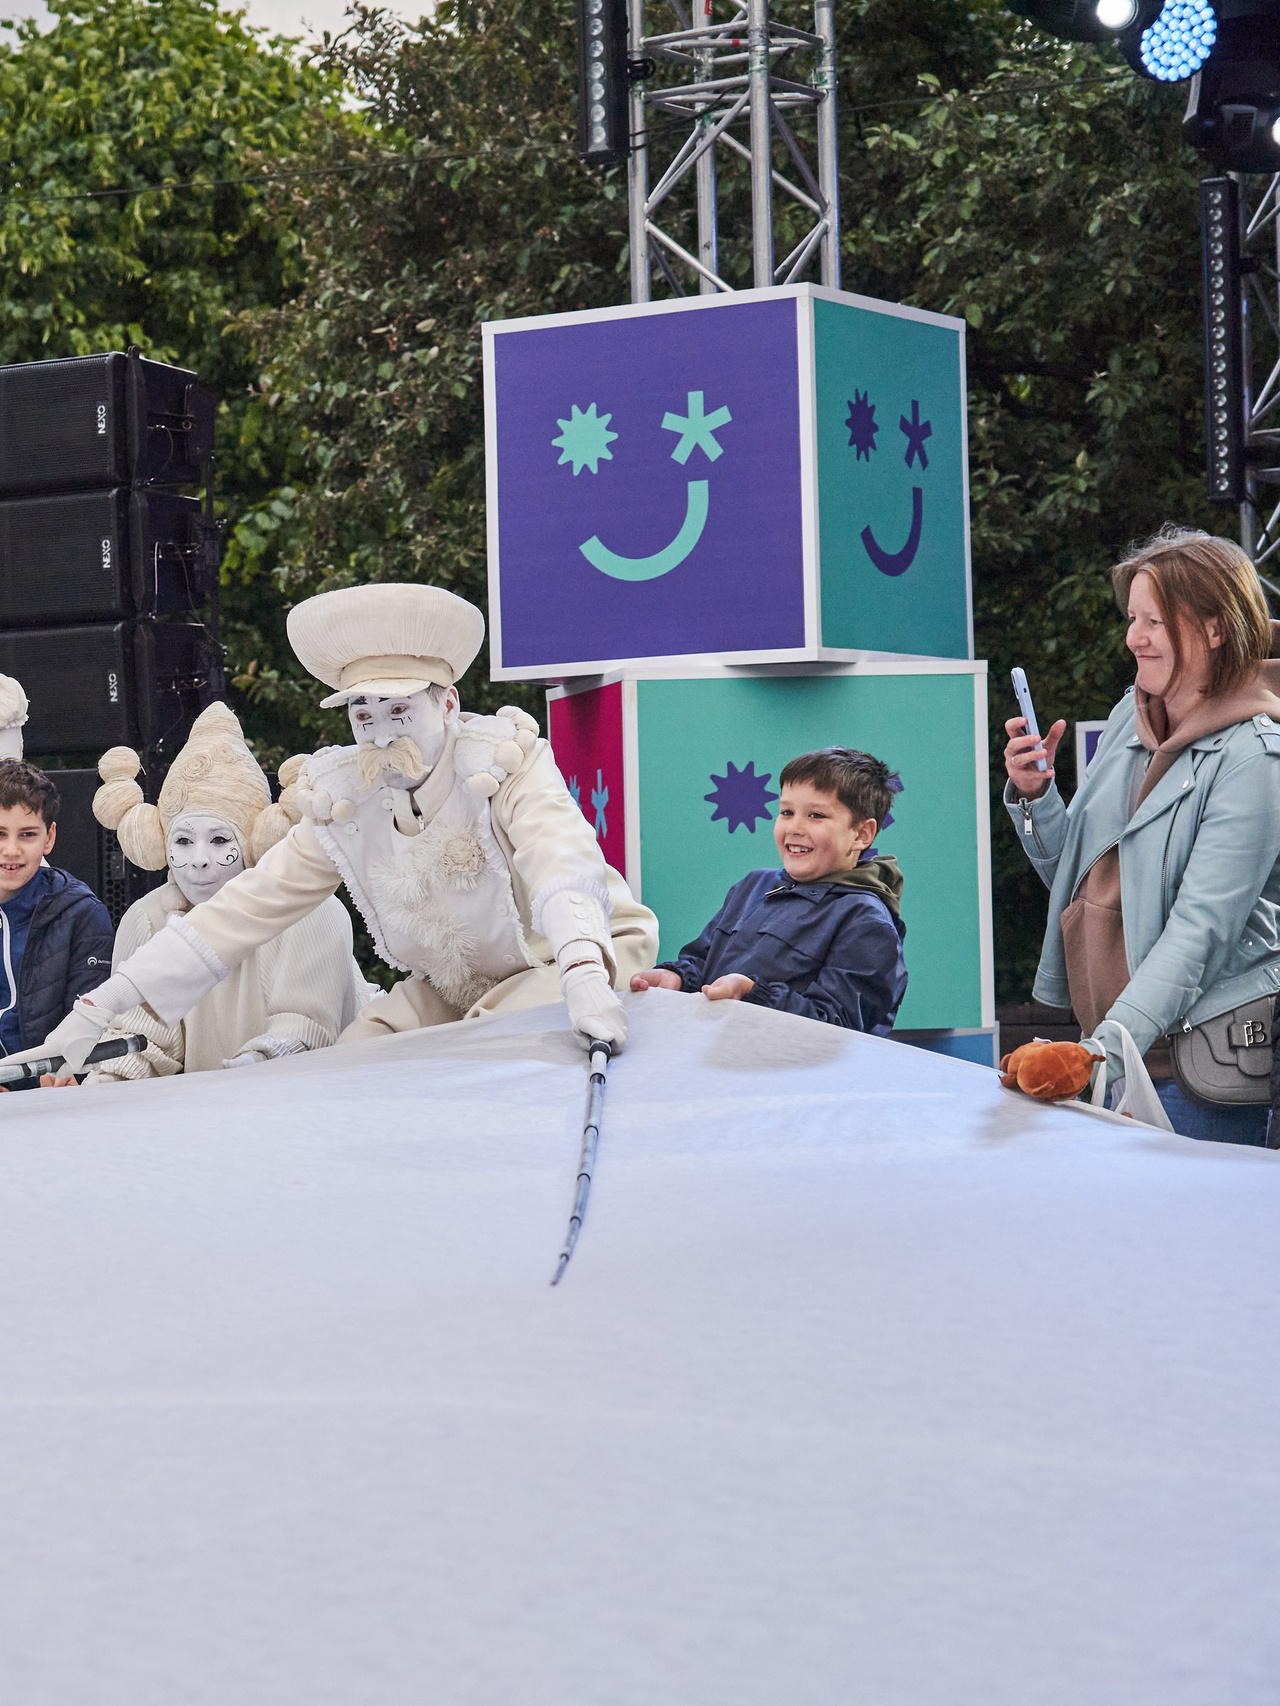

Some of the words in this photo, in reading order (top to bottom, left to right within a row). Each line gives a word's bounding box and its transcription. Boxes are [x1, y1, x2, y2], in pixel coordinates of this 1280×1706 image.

[97, 404, 106, 434] NEXO
[102, 539, 111, 568] NEXO
[109, 672, 118, 702] NEXO
